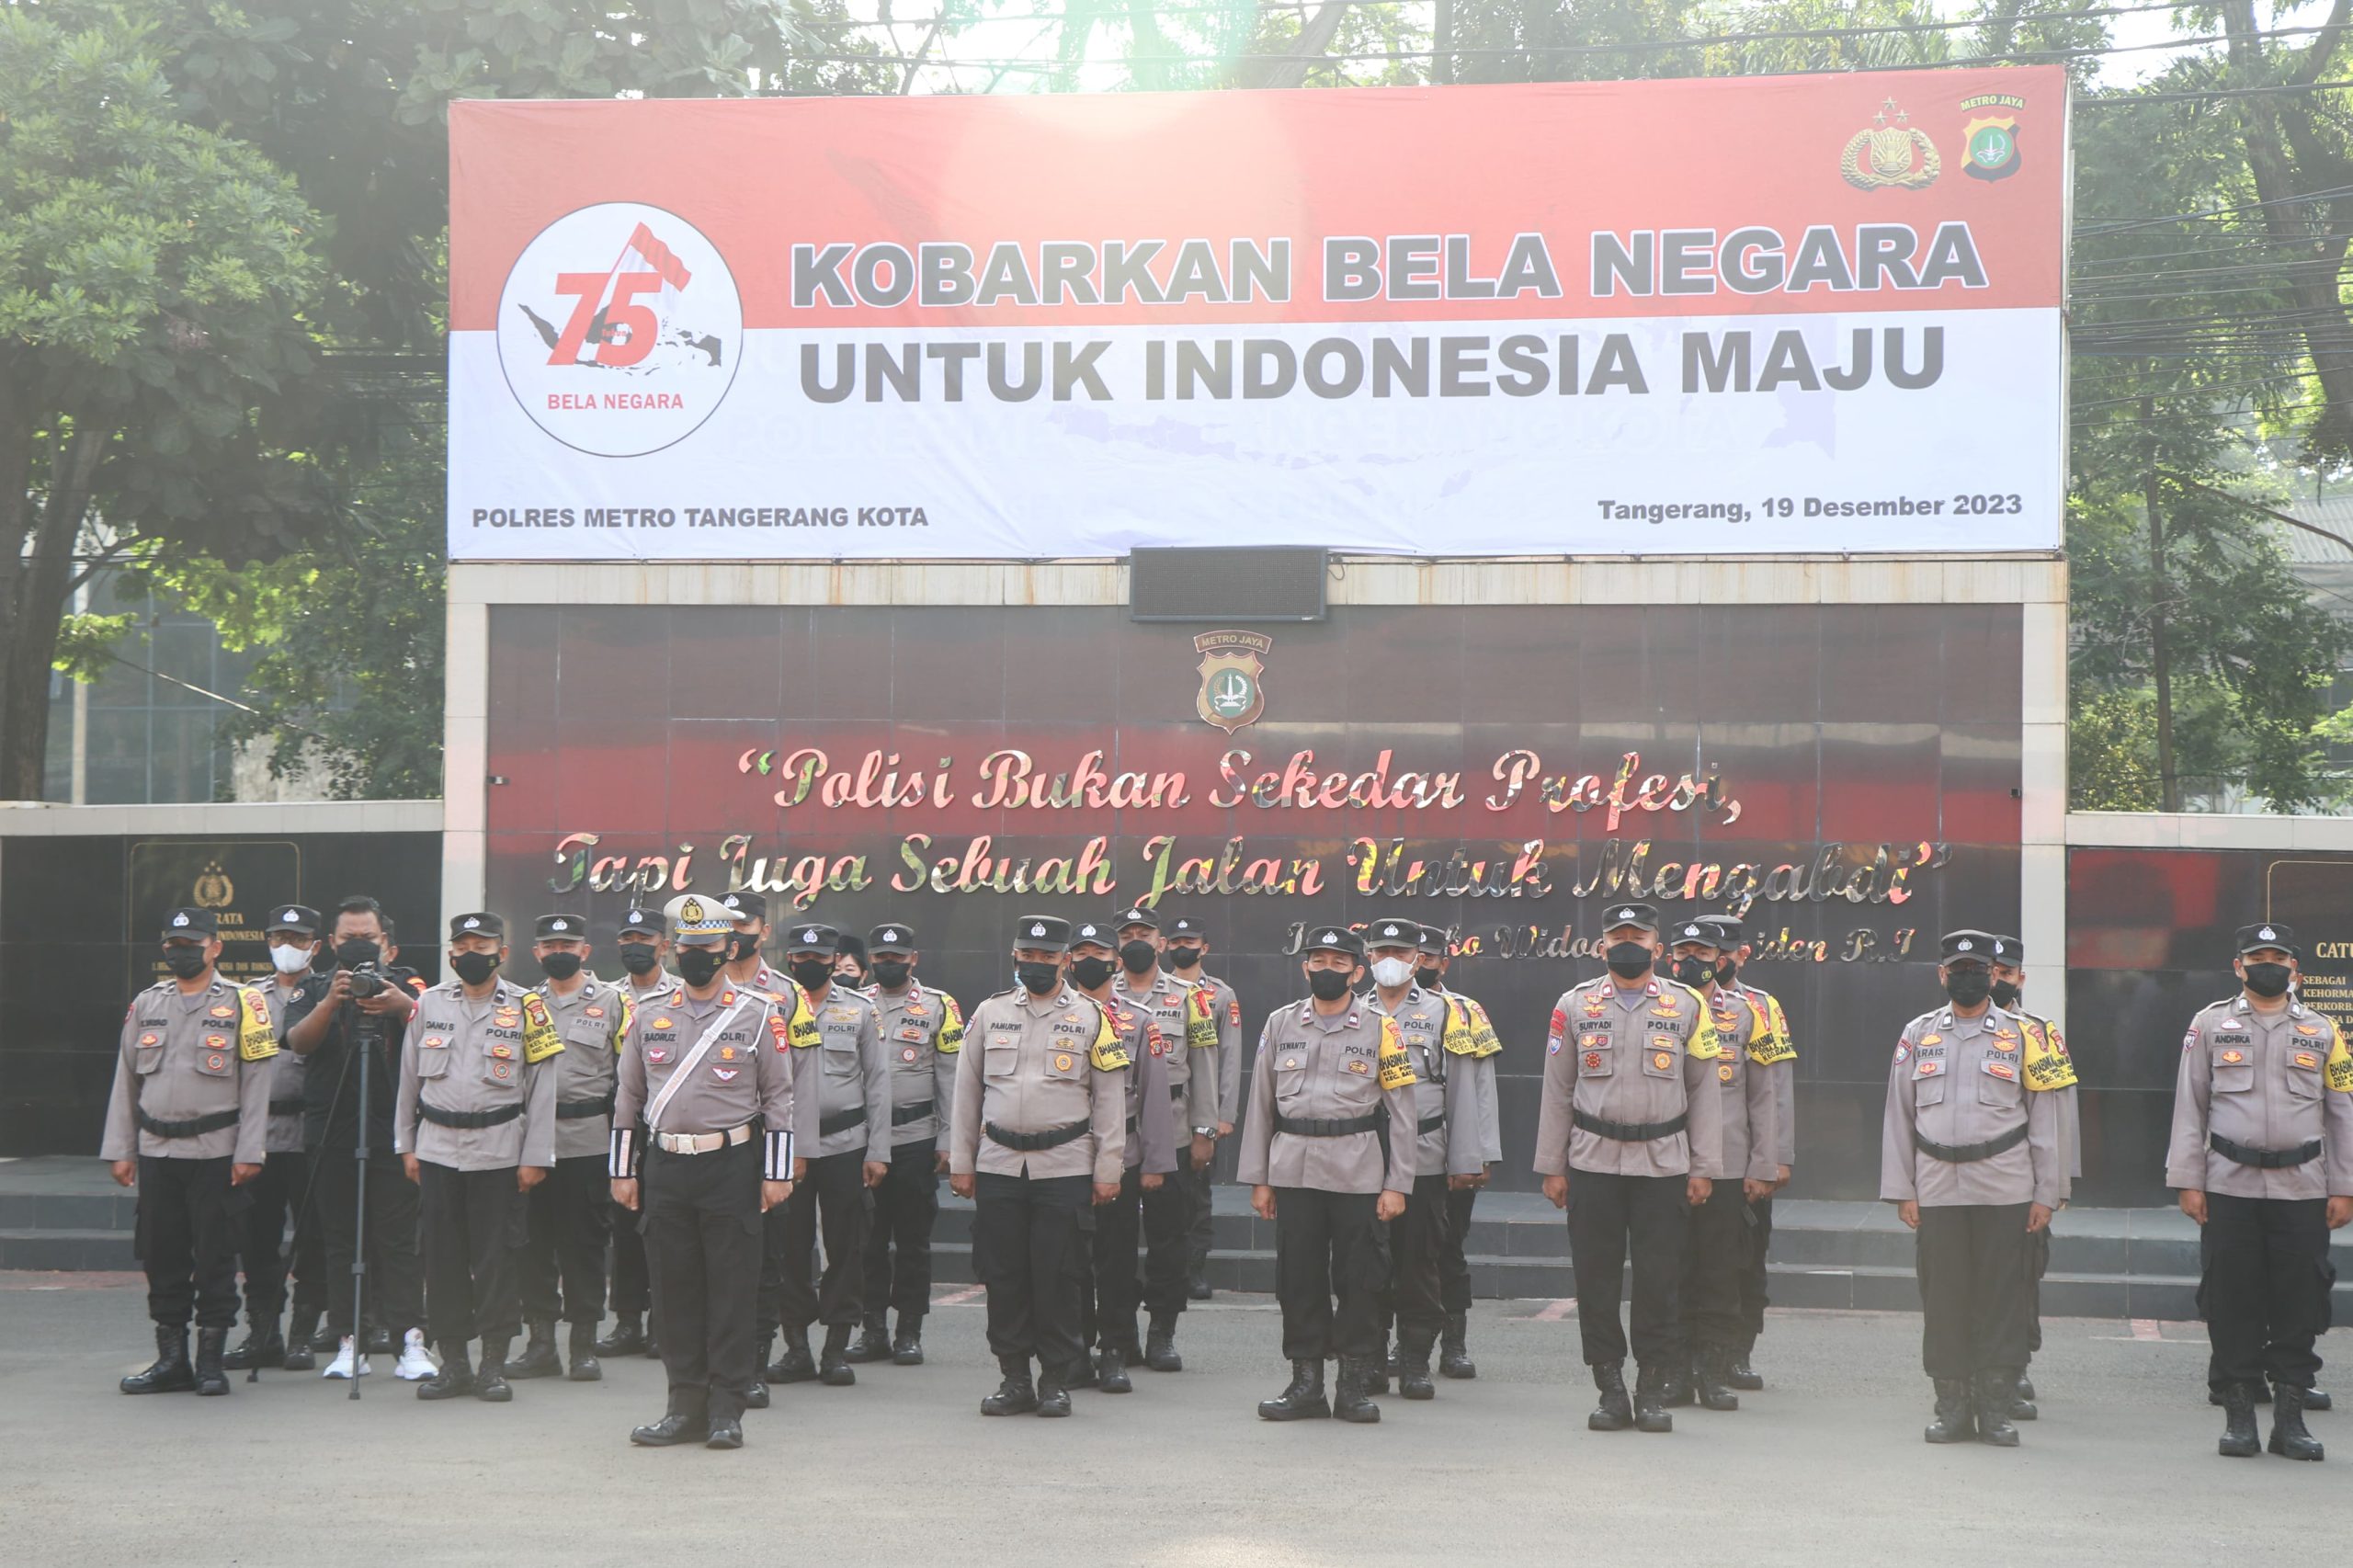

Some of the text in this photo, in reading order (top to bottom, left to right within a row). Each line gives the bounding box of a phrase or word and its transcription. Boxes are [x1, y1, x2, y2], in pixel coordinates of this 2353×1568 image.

[1961, 95, 2024, 110] METRO JAYA
[791, 221, 1990, 307] KOBARKAN BELA NEGARA
[546, 272, 664, 368] 75
[801, 326, 1944, 403] UNTUK INDONESIA MAJU
[547, 392, 684, 410] BELA NEGARA
[1597, 494, 2022, 525] Tangerang, 19 Desember 2023
[472, 506, 928, 528] POLRES METRO TANGERANG KOTA
[1202, 635, 1264, 648] METRO JAYA
[972, 748, 1189, 810] Bukan
[1209, 749, 1465, 810] Sekedar
[1485, 749, 1742, 832] Profesi,
[547, 833, 695, 908] Tapi
[719, 834, 873, 911] Juga
[891, 834, 1117, 895] Sebuah
[1133, 835, 1324, 908] Jalan
[1347, 836, 1552, 898] Untuk
[2302, 976, 2346, 985] SEBAGAI
[1155, 1010, 1180, 1019] POLRI
[202, 1020, 235, 1029] POLRI
[576, 1018, 605, 1029] POLRI
[901, 1017, 929, 1028] POLRI
[1404, 1021, 1434, 1031] POLRI
[1579, 1021, 1611, 1031] SURYADI
[1647, 1021, 1680, 1032] POLRI
[485, 1028, 521, 1040] POLRI
[1053, 1024, 1086, 1035] POLRI
[643, 1032, 676, 1042] BADRUZ
[720, 1032, 745, 1042] OLRI
[2215, 1035, 2251, 1044] ANDHIKA
[2292, 1038, 2325, 1050] POLRI
[1345, 1046, 1376, 1059] POLRI
[1986, 1051, 2018, 1063] POLRI
